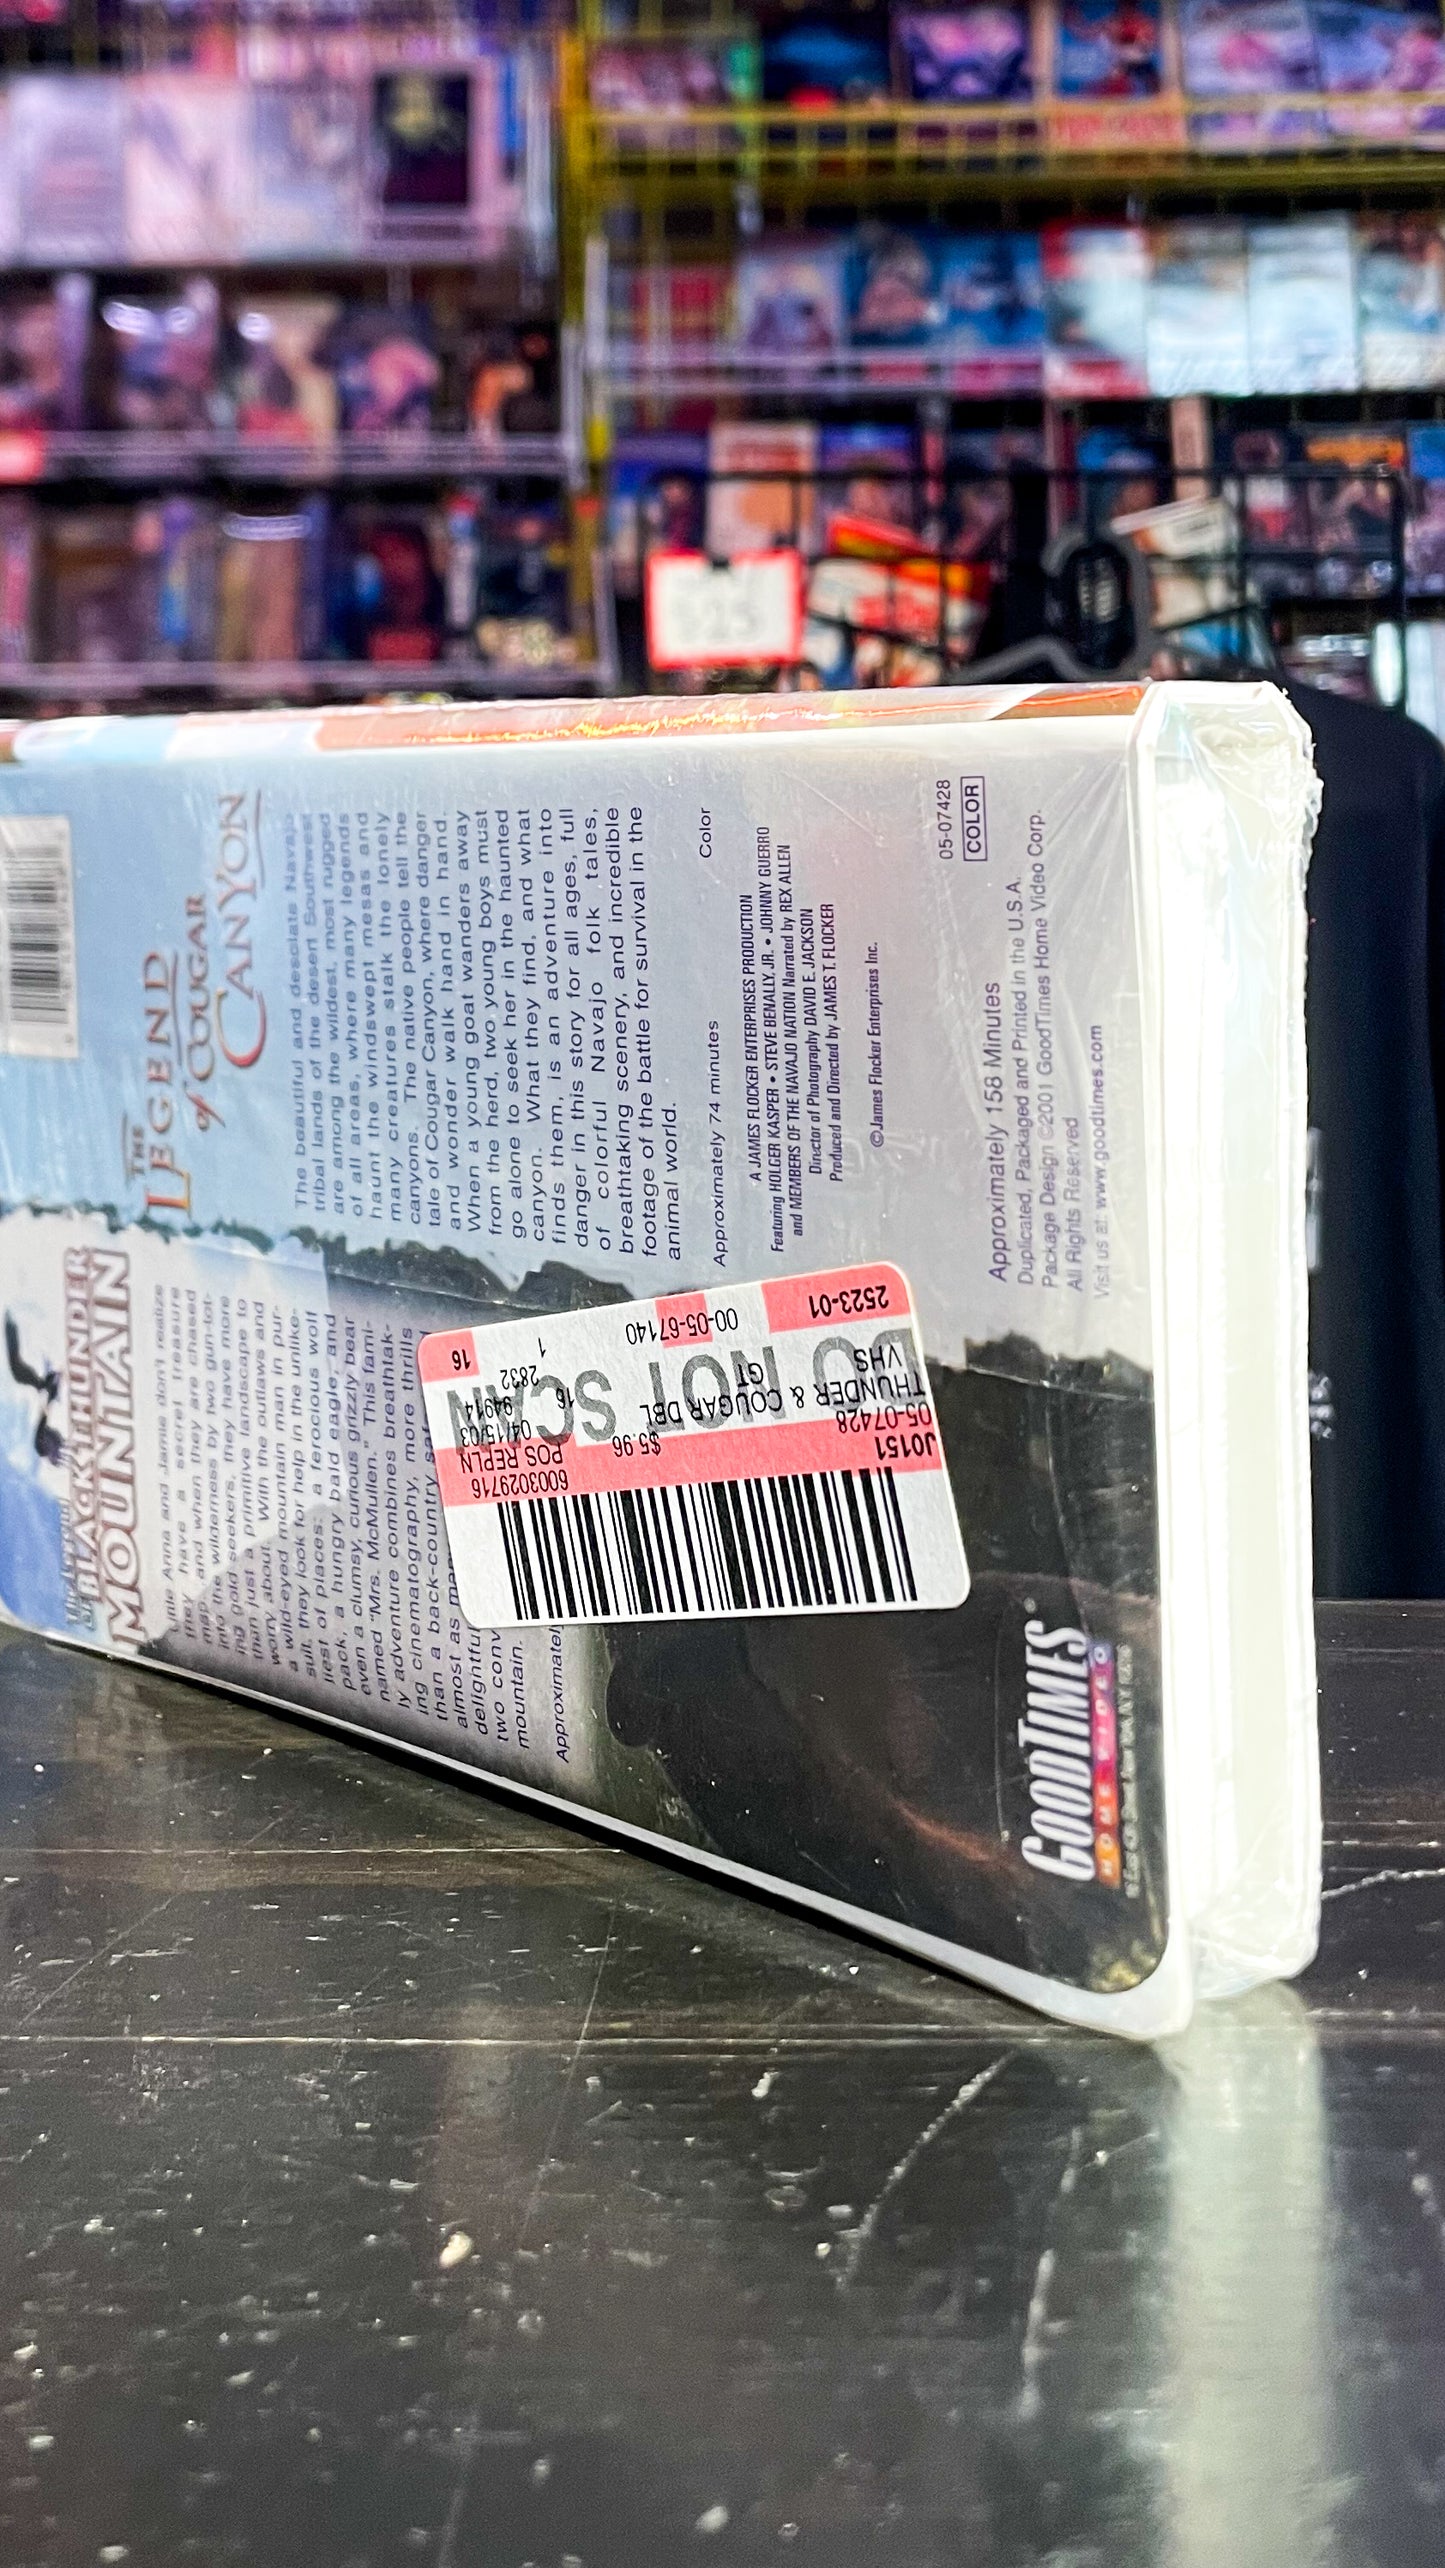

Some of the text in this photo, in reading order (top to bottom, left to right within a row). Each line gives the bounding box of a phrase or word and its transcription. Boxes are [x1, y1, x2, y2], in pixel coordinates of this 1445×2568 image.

[699, 808, 712, 858] Color
[936, 780, 953, 859] 05-07428
[965, 784, 982, 854] COLOR
[1027, 810, 1051, 857] Corp.
[757, 827, 771, 876] GUERRO
[759, 882, 773, 933] JOHNNY
[1029, 863, 1046, 912] Video
[215, 792, 267, 1067] CANYON
[800, 909, 815, 968] JACKSON
[820, 904, 835, 959] FLOCKER
[864, 942, 878, 963] Inc.
[1033, 918, 1050, 969] Home
[761, 950, 774, 969] JR.
[183, 894, 224, 1132] of COUGAR
[416, 812, 440, 1226] tale of Cougar Canyon, where danger
[803, 987, 817, 1026] DAVID
[823, 976, 837, 1020] JAMES
[866, 969, 883, 1036] Enterprises
[1035, 975, 1053, 1076] GoodTimes
[559, 809, 591, 1247] danger in this story for all ages, full
[605, 808, 633, 1253] breathtaking scenery, and incredible
[628, 807, 659, 1256] footage of the battle for survival in the
[739, 895, 761, 1181] A JAMES FLOCKER ENTERPRISES PRODUCTION
[764, 1031, 778, 1070] STEVE
[777, 845, 802, 1236] and MEMBERS OF THE NAVAJO NATION Narrated by REX ALLEN
[825, 1025, 840, 1039] by
[142, 951, 190, 1217] LEGEND
[805, 1030, 821, 1106] Photography
[825, 1043, 840, 1094] Directed
[868, 1040, 882, 1085] Flocker
[1006, 877, 1036, 1285] Duplicated, Packaged and Printed in the U.S.A.
[766, 1089, 780, 1138] KASPER
[807, 1110, 820, 1122] of
[827, 1098, 841, 1120] and
[983, 983, 1012, 1282] Approximately 158 Minutes
[1089, 1025, 1110, 1209] www.goodtimes.com
[708, 1021, 728, 1267] Approximately 74 minutes
[768, 1143, 781, 1192] HOLGER
[809, 1126, 822, 1174] Director
[828, 1125, 843, 1181] Produced
[661, 1103, 680, 1260] animal world.
[1039, 1146, 1059, 1206] Design
[770, 1196, 785, 1252] Featuring
[1062, 1117, 1087, 1293] All Rights Reserved
[1042, 1212, 1061, 1288] Package
[626, 1308, 739, 1345] 00-05-67140
[809, 1285, 889, 1318] 2523-01
[65, 1246, 94, 1445] THUNDER
[362, 1322, 374, 1373] fami-
[452, 1349, 471, 1371] 16
[538, 1337, 546, 1358] 1
[853, 1344, 902, 1373] VHS
[499, 1365, 539, 1389] 2832
[639, 1371, 925, 1426] THUNDER & COUGAR DBL
[648, 1346, 786, 1434] NOT
[737, 1362, 764, 1388] GT
[363, 1383, 376, 1426] This
[446, 1370, 616, 1455] SCAN
[464, 1396, 513, 1420] 94914
[836, 1401, 931, 1433] 05-07428
[90, 1247, 147, 1644] MOUNTAIN
[459, 1442, 563, 1473] POS REPLN
[460, 1419, 532, 1447] 04/15/03
[612, 1431, 661, 1457] $5.96
[874, 1431, 936, 1460] J0151
[471, 1469, 568, 1499] 6003029716
[71, 1460, 100, 1599] BLACK
[381, 1325, 411, 1708] ly adventure combines breathtak-
[400, 1328, 429, 1715] ing cinematography, more thrills
[424, 1470, 441, 1634] back-country
[370, 1630, 390, 1702] named
[431, 1647, 440, 1660] a
[467, 1624, 488, 1735] delightful
[433, 1672, 448, 1720] than
[511, 1641, 529, 1748] mountain.
